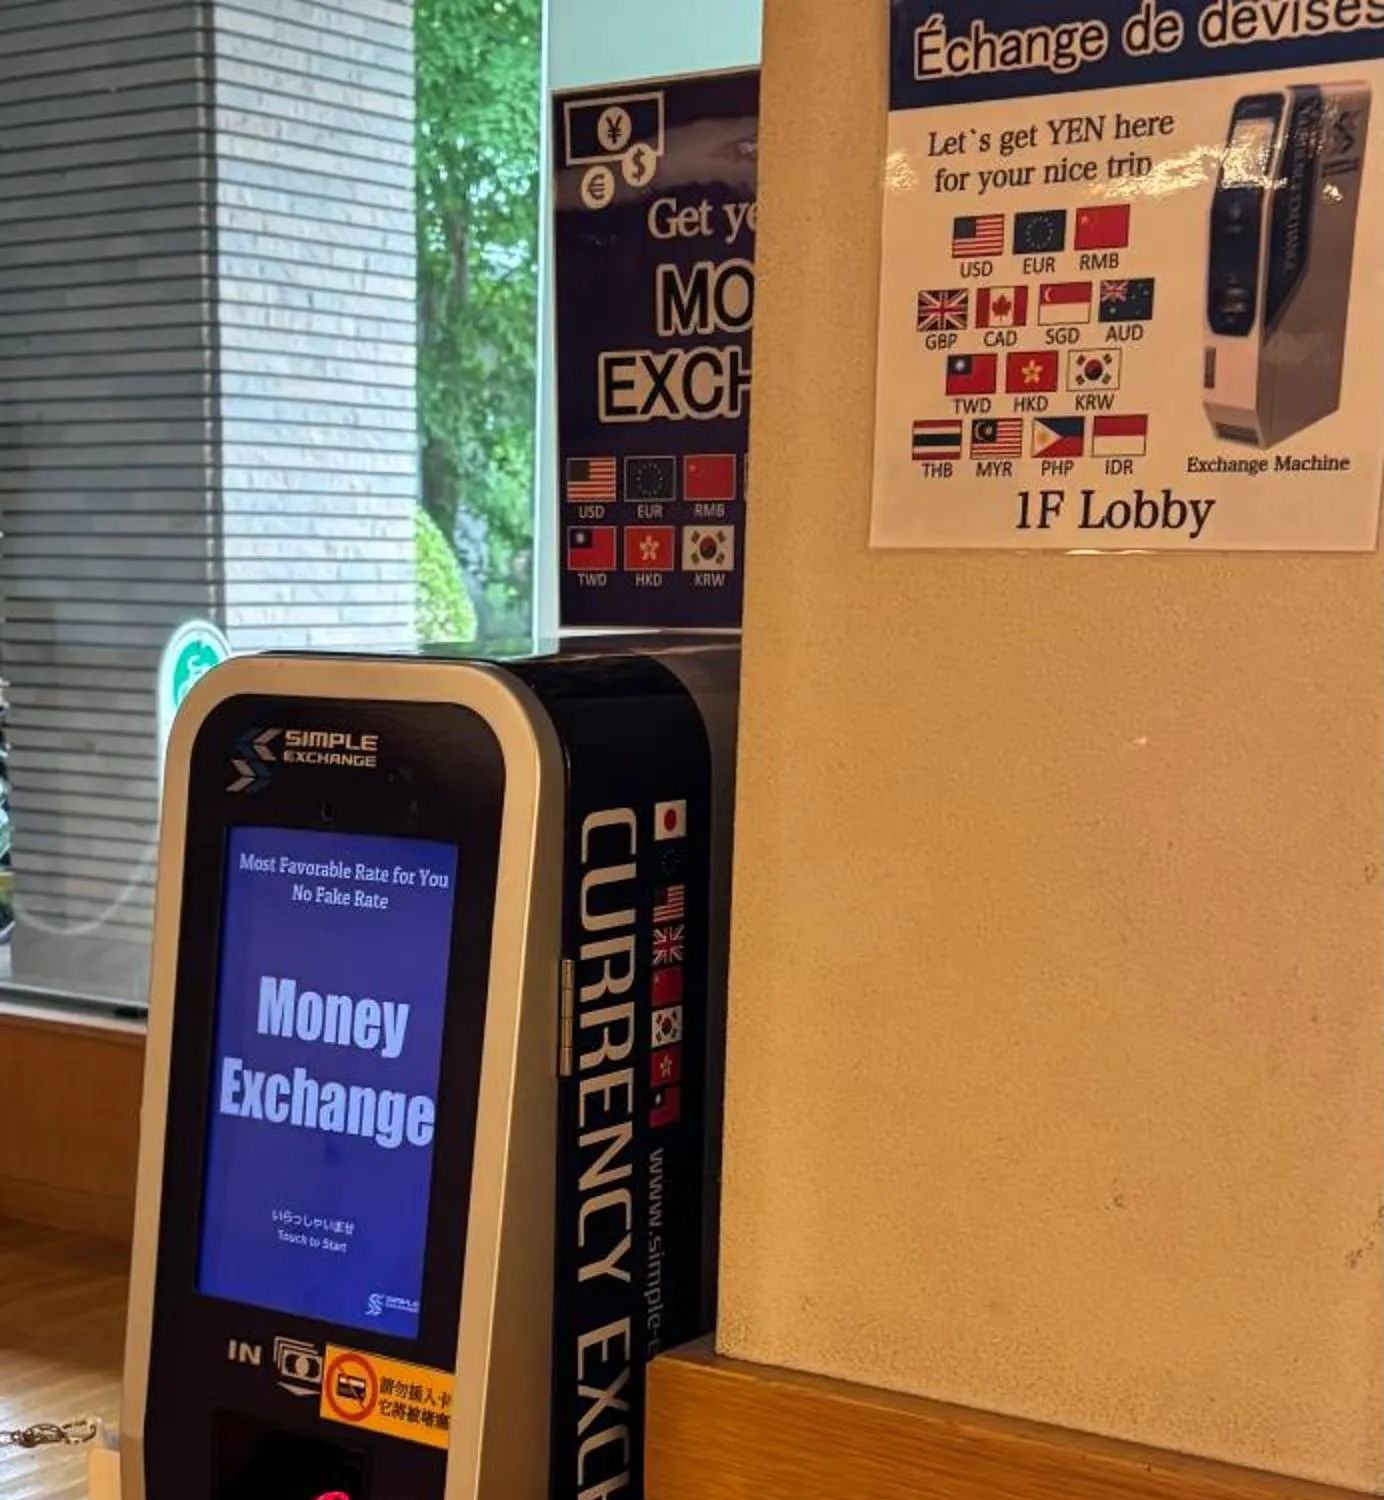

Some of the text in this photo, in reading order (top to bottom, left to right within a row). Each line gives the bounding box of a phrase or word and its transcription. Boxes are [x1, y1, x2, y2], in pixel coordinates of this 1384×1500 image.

[914, 13, 1108, 80] Échange
[1122, 0, 1183, 56] de
[999, 124, 1037, 155] get
[1047, 115, 1105, 146] YEN
[1114, 112, 1175, 140] here
[935, 152, 1152, 195] for your nice trip
[648, 198, 714, 239] Get
[960, 252, 1120, 278] USD EUR RMB
[656, 258, 755, 337] MO
[925, 324, 1144, 351] GBP CAD SGD AUD
[954, 394, 1115, 414] TWD HKD KRW
[921, 458, 1133, 479] THB MYR PHP IDR
[1186, 454, 1350, 478] Exchange Machine
[578, 503, 725, 518] USD EUR RMB
[1016, 489, 1215, 538] 1F Lobby
[578, 573, 726, 587] TWD HKD KRW
[284, 729, 379, 751] SIMPLE
[283, 750, 377, 768] EXCHANGE
[239, 852, 449, 889] Most Favorable Rate for You
[292, 884, 388, 909] No Fake Rate
[256, 975, 410, 1059] Money
[577, 807, 638, 1284] CURRENCY
[219, 1056, 436, 1150] Exchange
[272, 1209, 355, 1235] いらっしゃいませ
[278, 1229, 347, 1254] Touch to Start
[227, 1339, 262, 1366] IN
